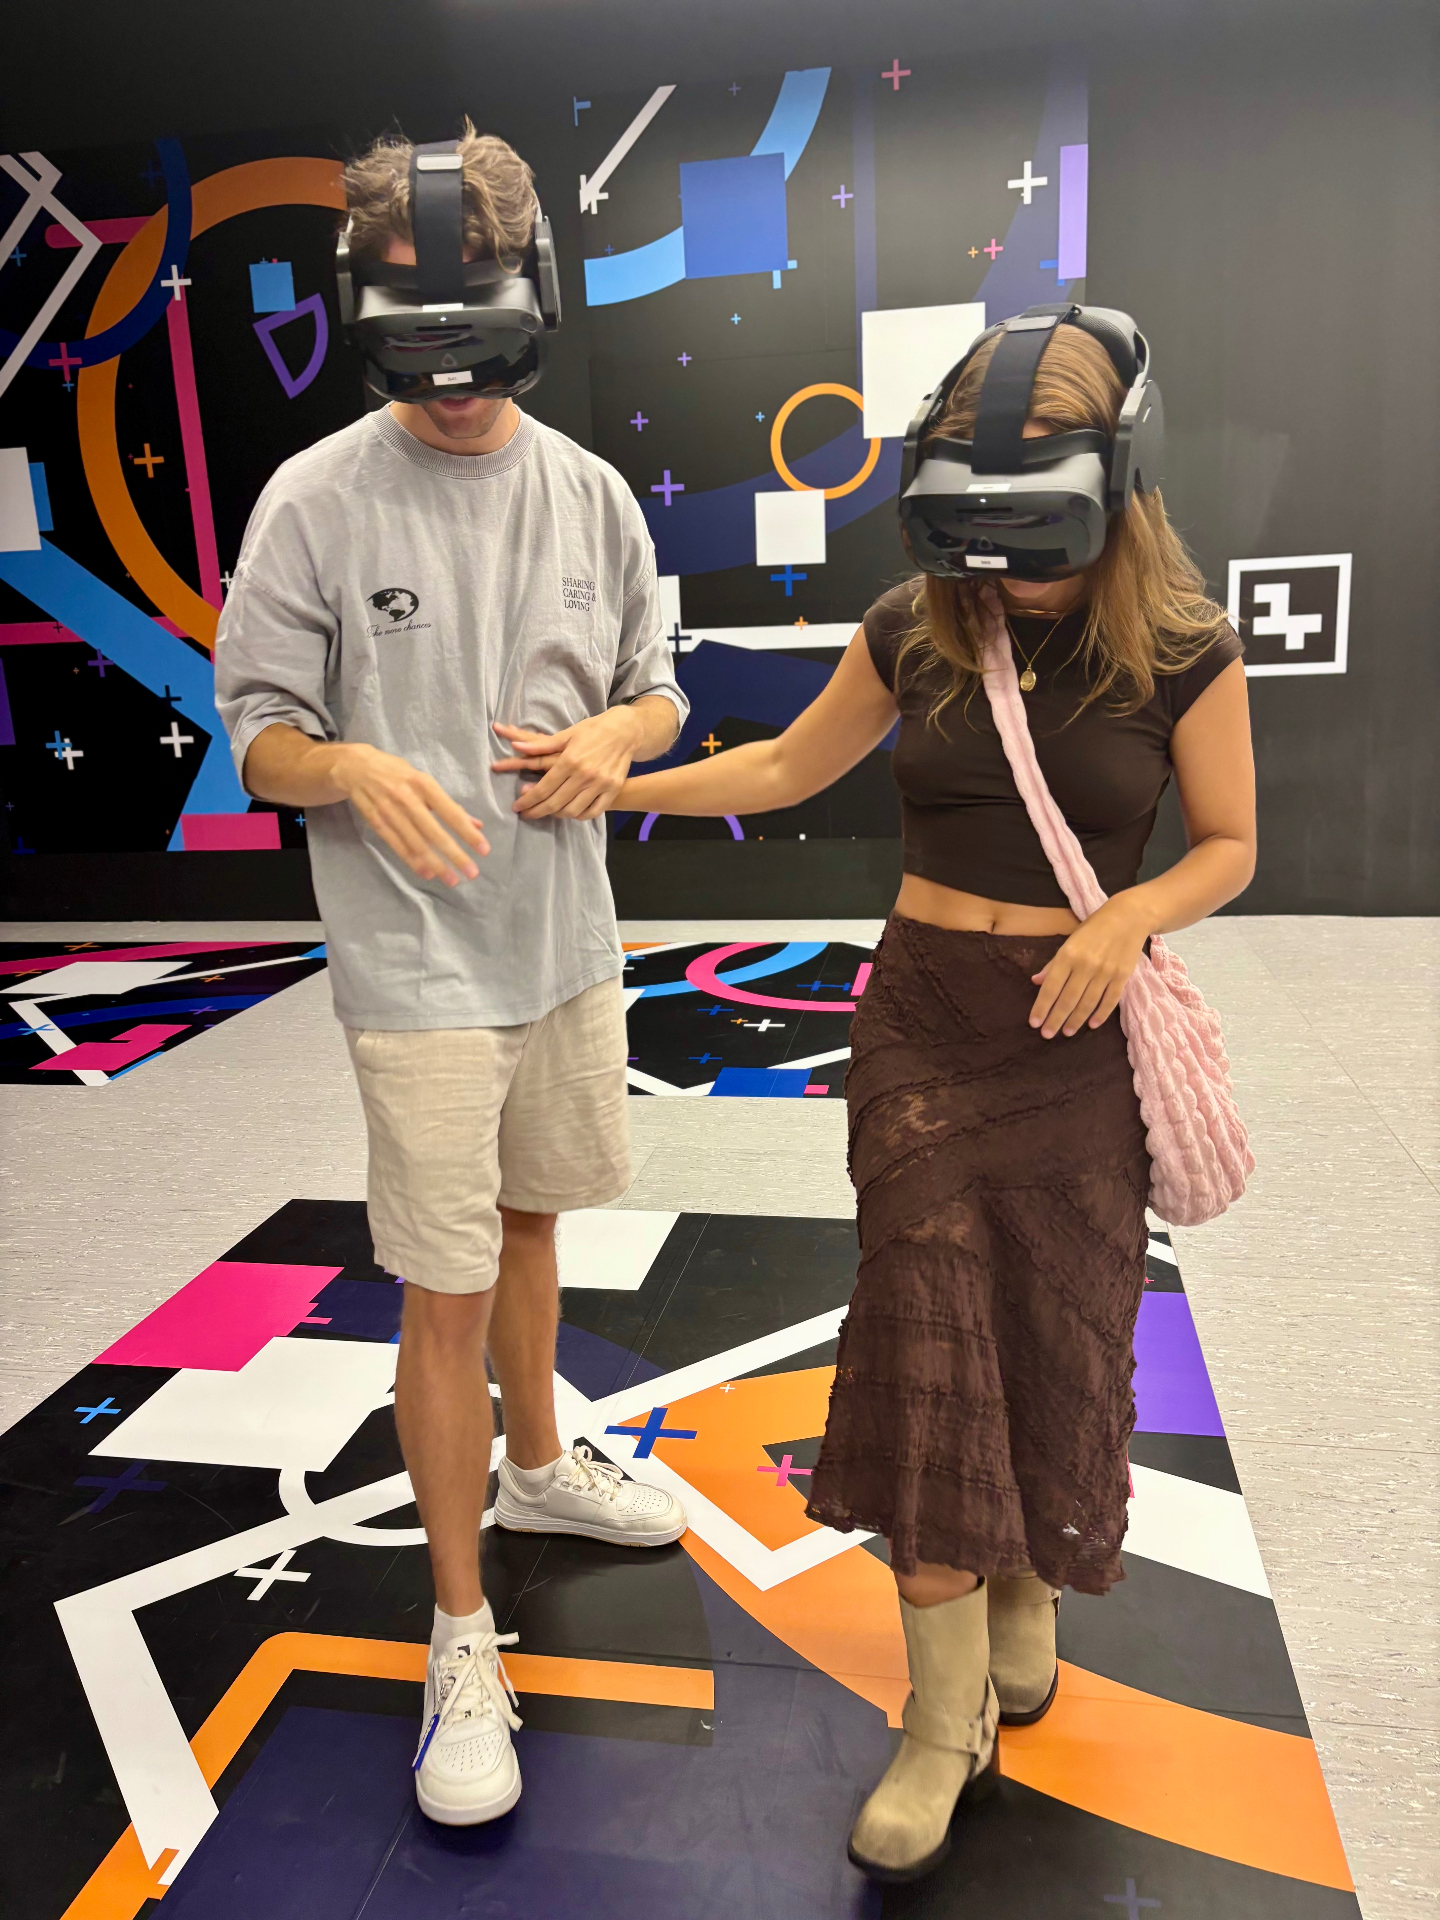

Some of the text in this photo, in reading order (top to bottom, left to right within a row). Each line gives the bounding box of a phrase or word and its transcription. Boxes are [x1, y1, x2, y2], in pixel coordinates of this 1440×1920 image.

[562, 577, 595, 591] SHARING
[563, 588, 596, 602] CARING &
[564, 599, 590, 611] LOVING
[403, 619, 431, 631] chances
